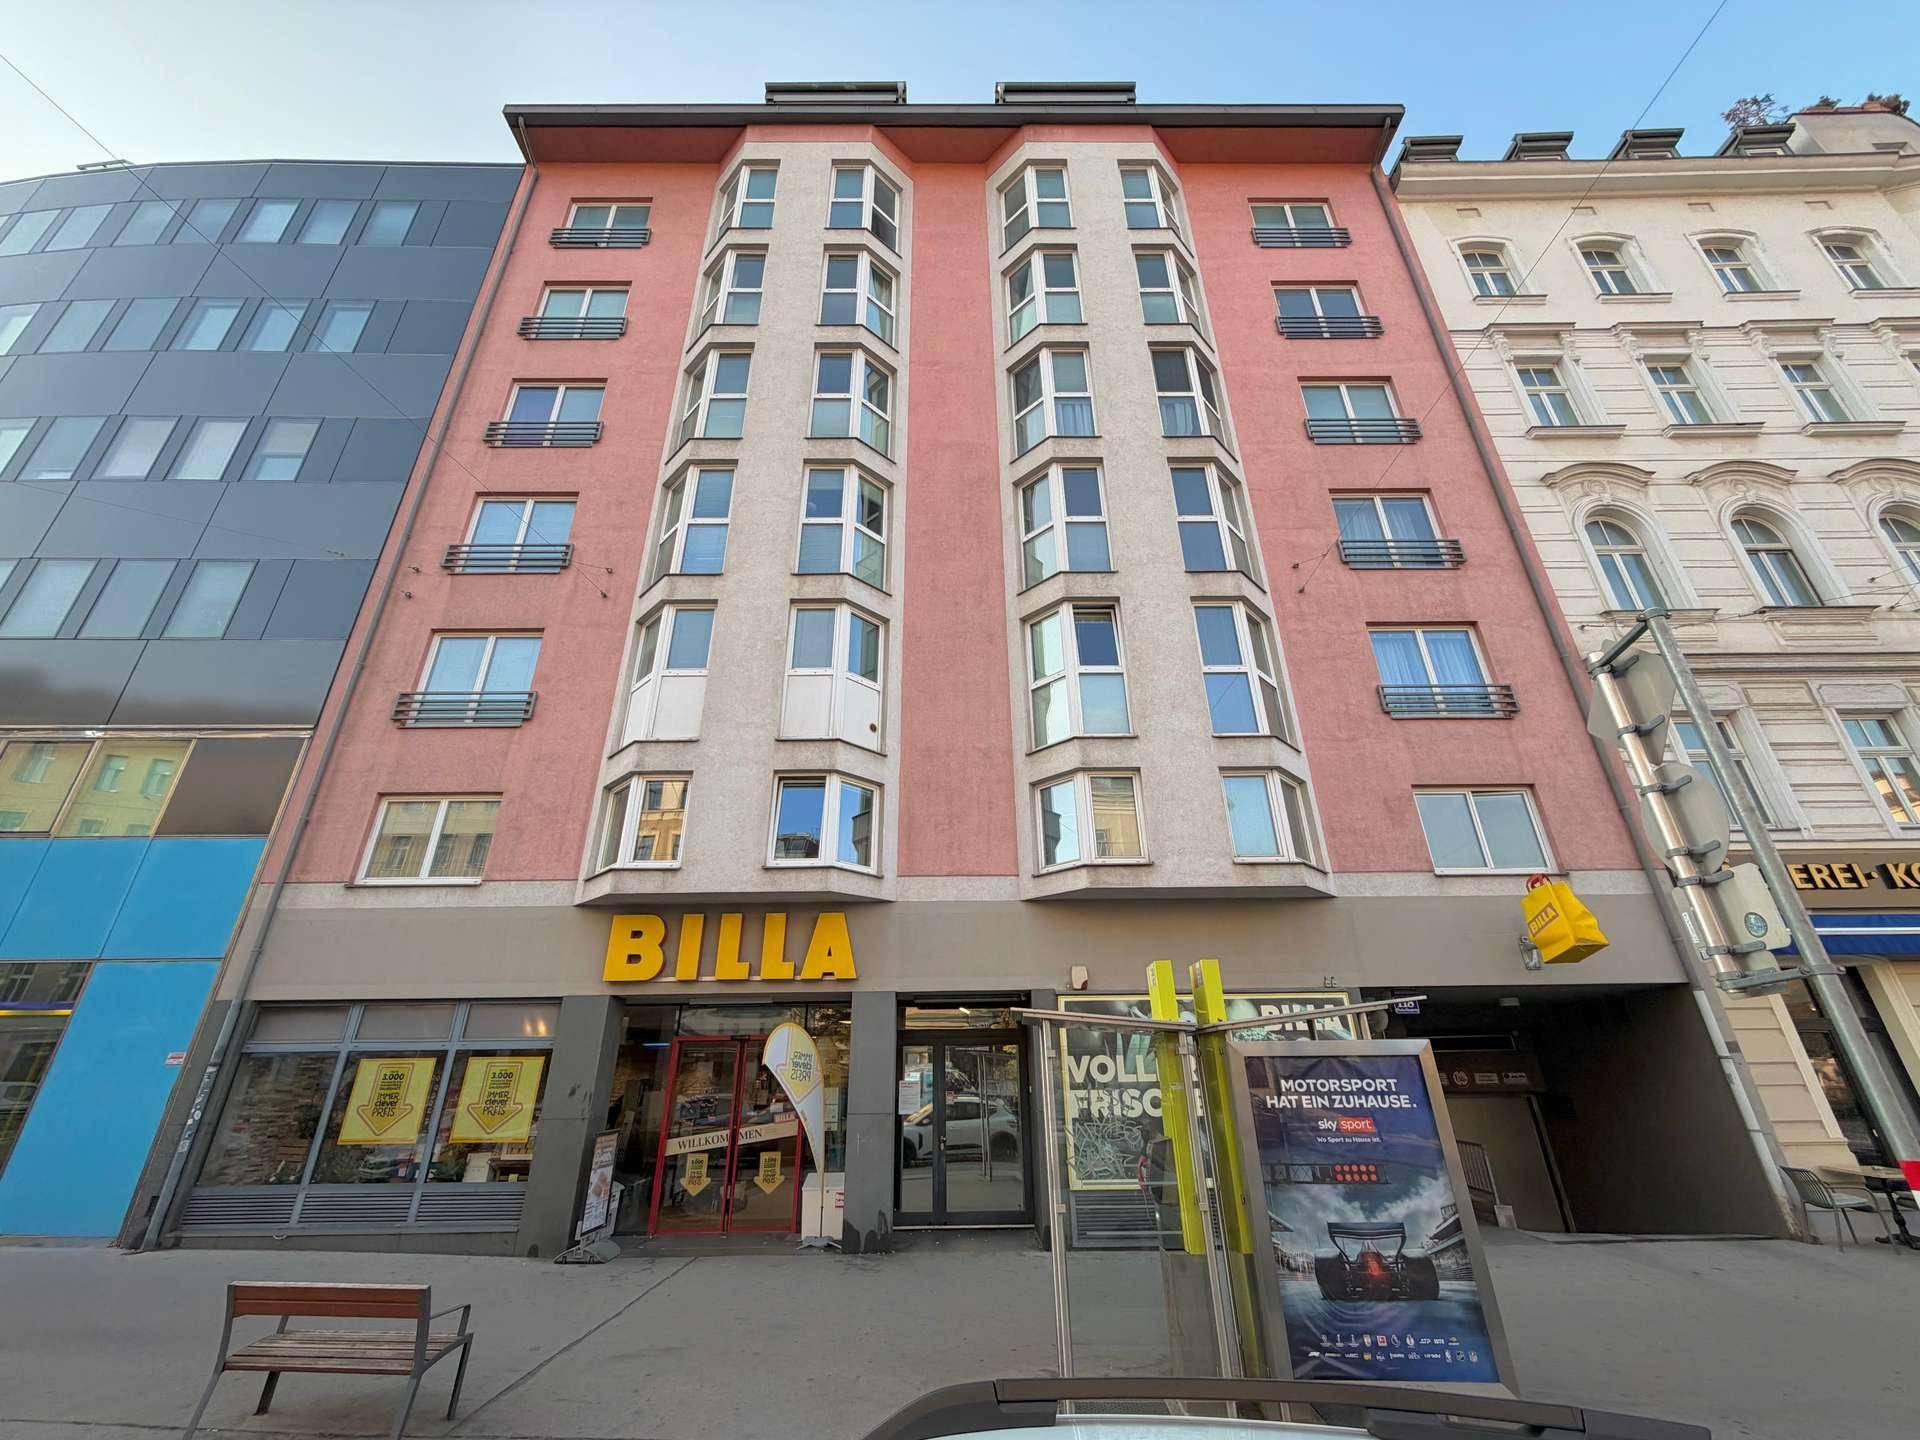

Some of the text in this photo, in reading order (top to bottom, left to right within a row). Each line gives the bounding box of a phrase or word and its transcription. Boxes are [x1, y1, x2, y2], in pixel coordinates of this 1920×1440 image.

[1530, 905, 1557, 935] BILLA
[603, 912, 857, 982] BILLA
[1067, 1054, 1199, 1083] VOLL
[382, 1073, 405, 1081] 3.000
[490, 1072, 514, 1080] 3.000
[1280, 1078, 1398, 1092] MOTORSPORT
[377, 1092, 401, 1101] IMMER
[486, 1090, 510, 1101] IMMER
[1265, 1094, 1418, 1109] HAT EIN ZUHAUSE.
[374, 1100, 399, 1108] clever
[484, 1098, 508, 1107] clever
[1070, 1088, 1204, 1118] FRISC
[371, 1107, 396, 1118] PREIS
[482, 1105, 506, 1117] PREIS
[1317, 1117, 1374, 1132] sky sport
[677, 1128, 762, 1151] WILLKOMMEN
[1327, 1135, 1344, 1145] Sport
